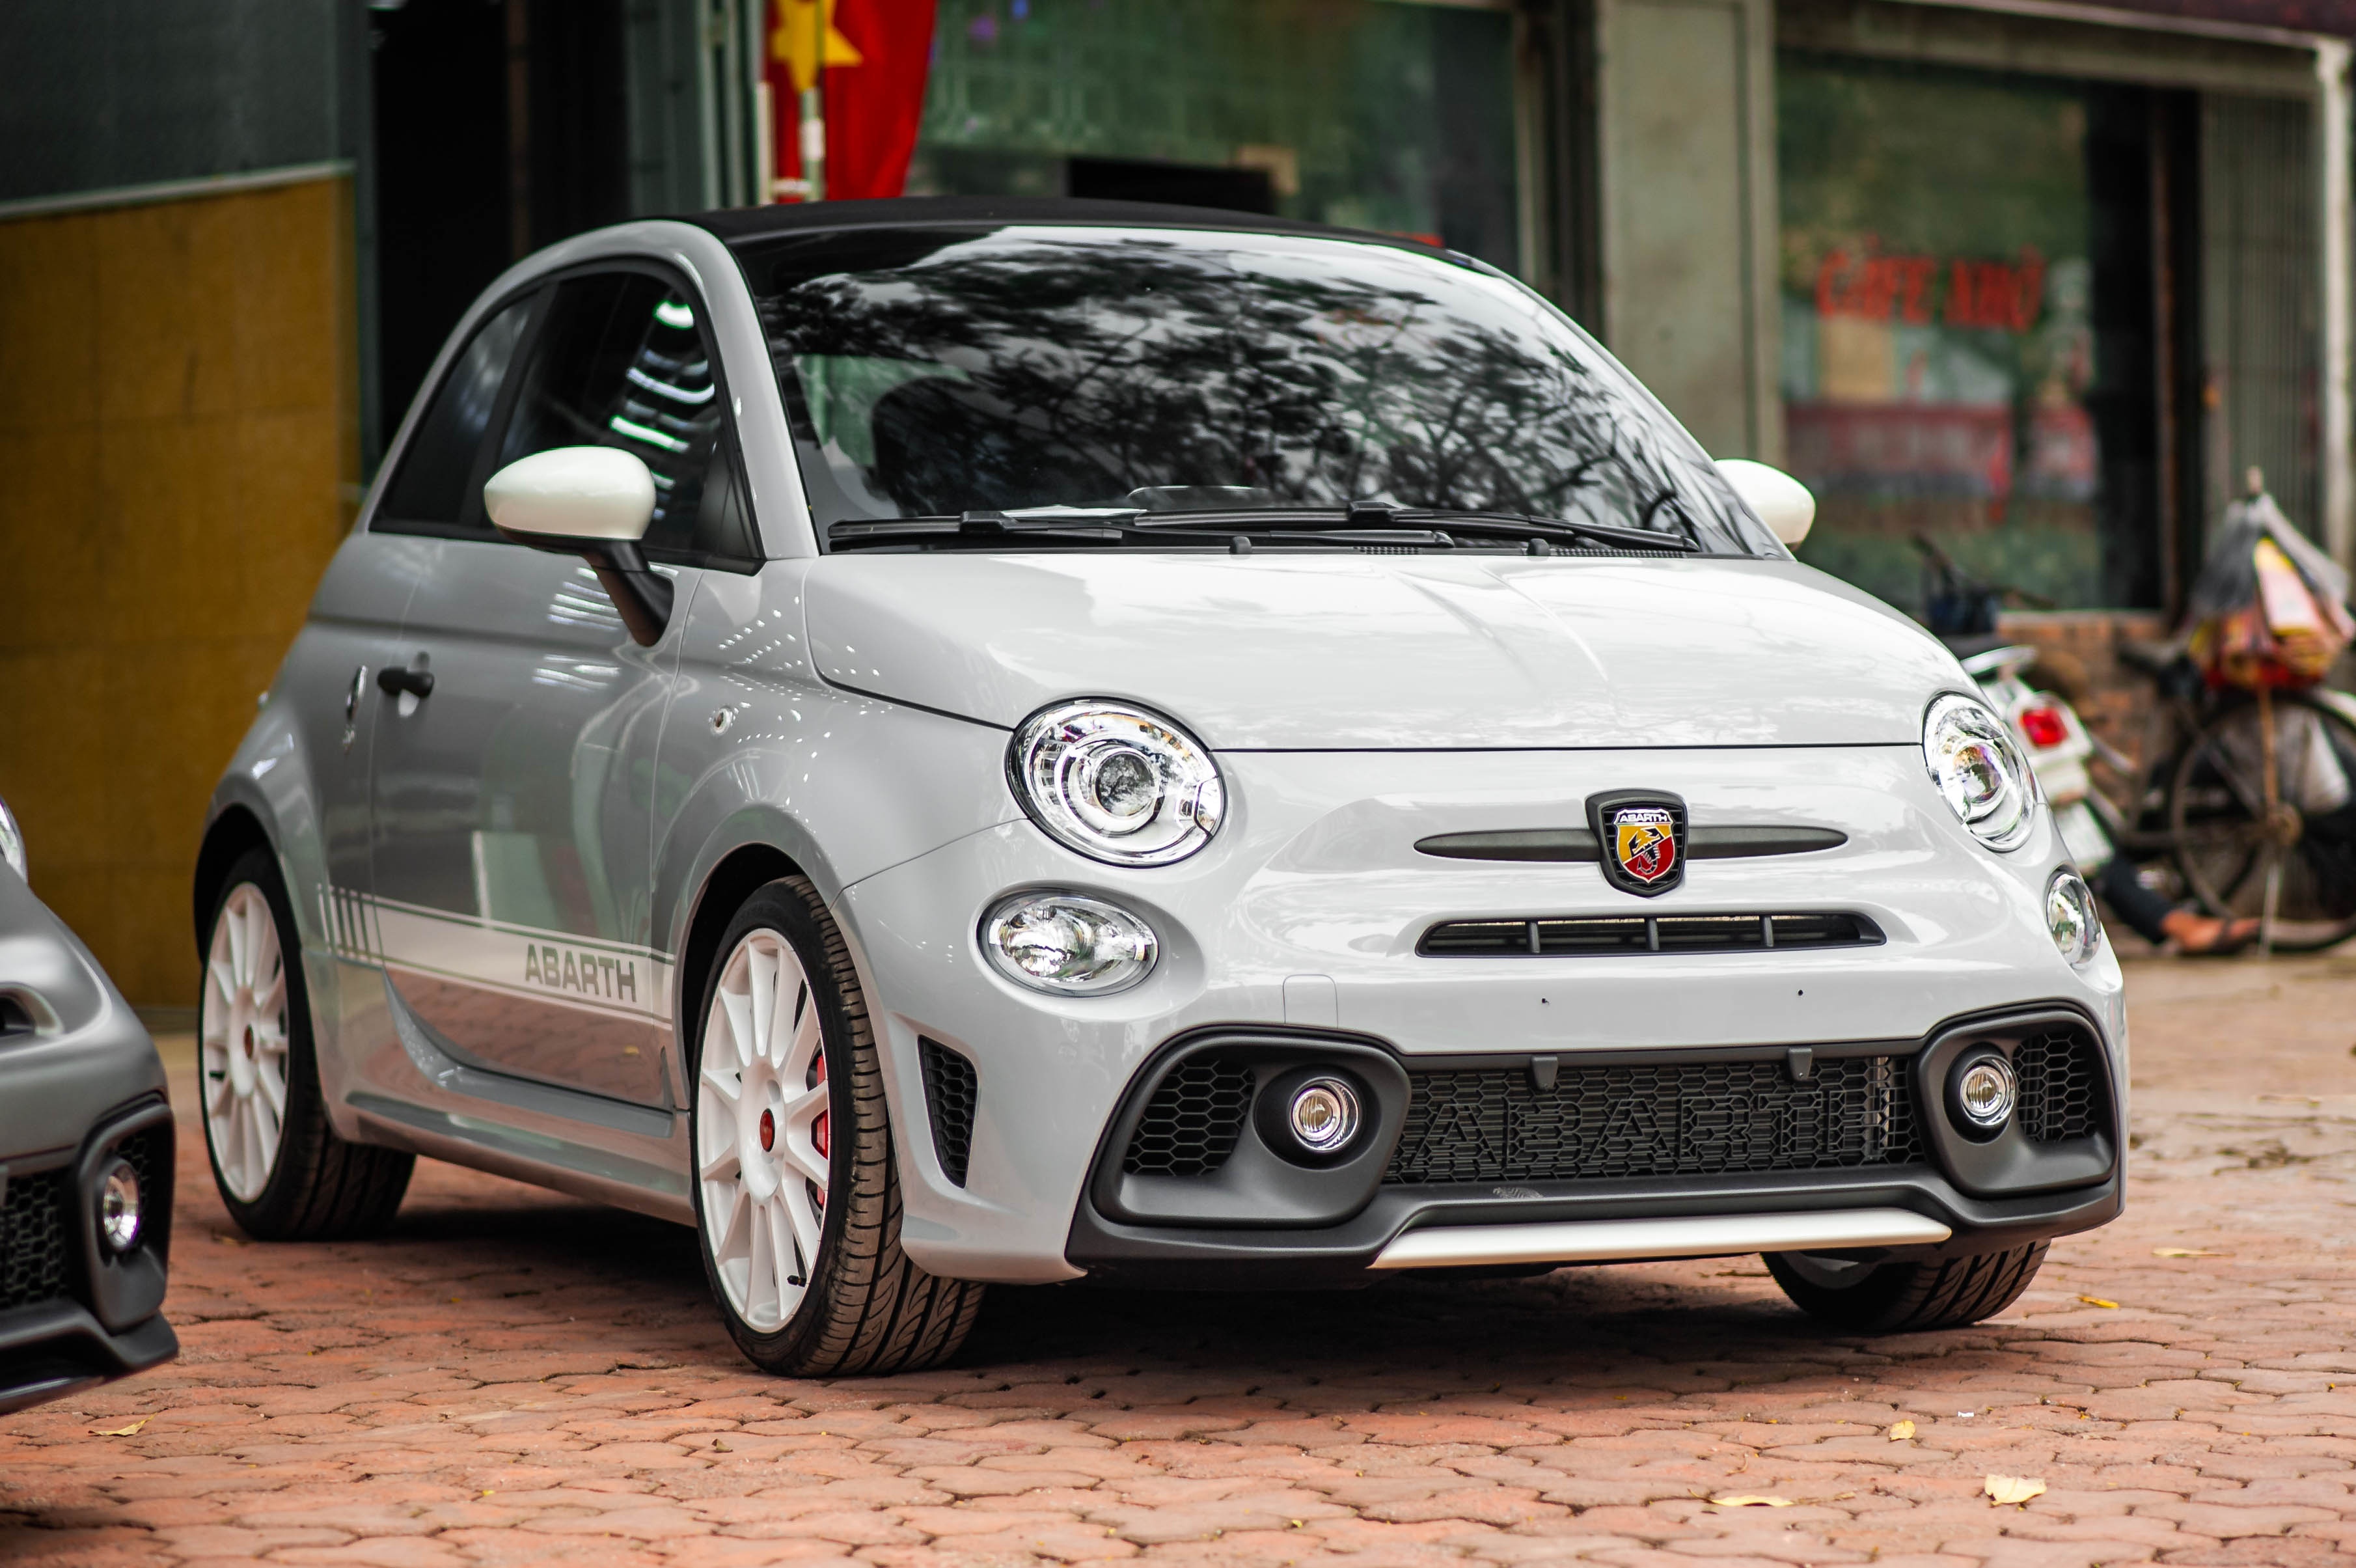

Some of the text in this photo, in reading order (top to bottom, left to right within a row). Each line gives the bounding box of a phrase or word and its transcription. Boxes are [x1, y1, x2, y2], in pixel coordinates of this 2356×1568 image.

[1619, 814, 1667, 822] ABARTH
[525, 943, 637, 1002] ABARTH
[1408, 1088, 1897, 1169] ABARTH
